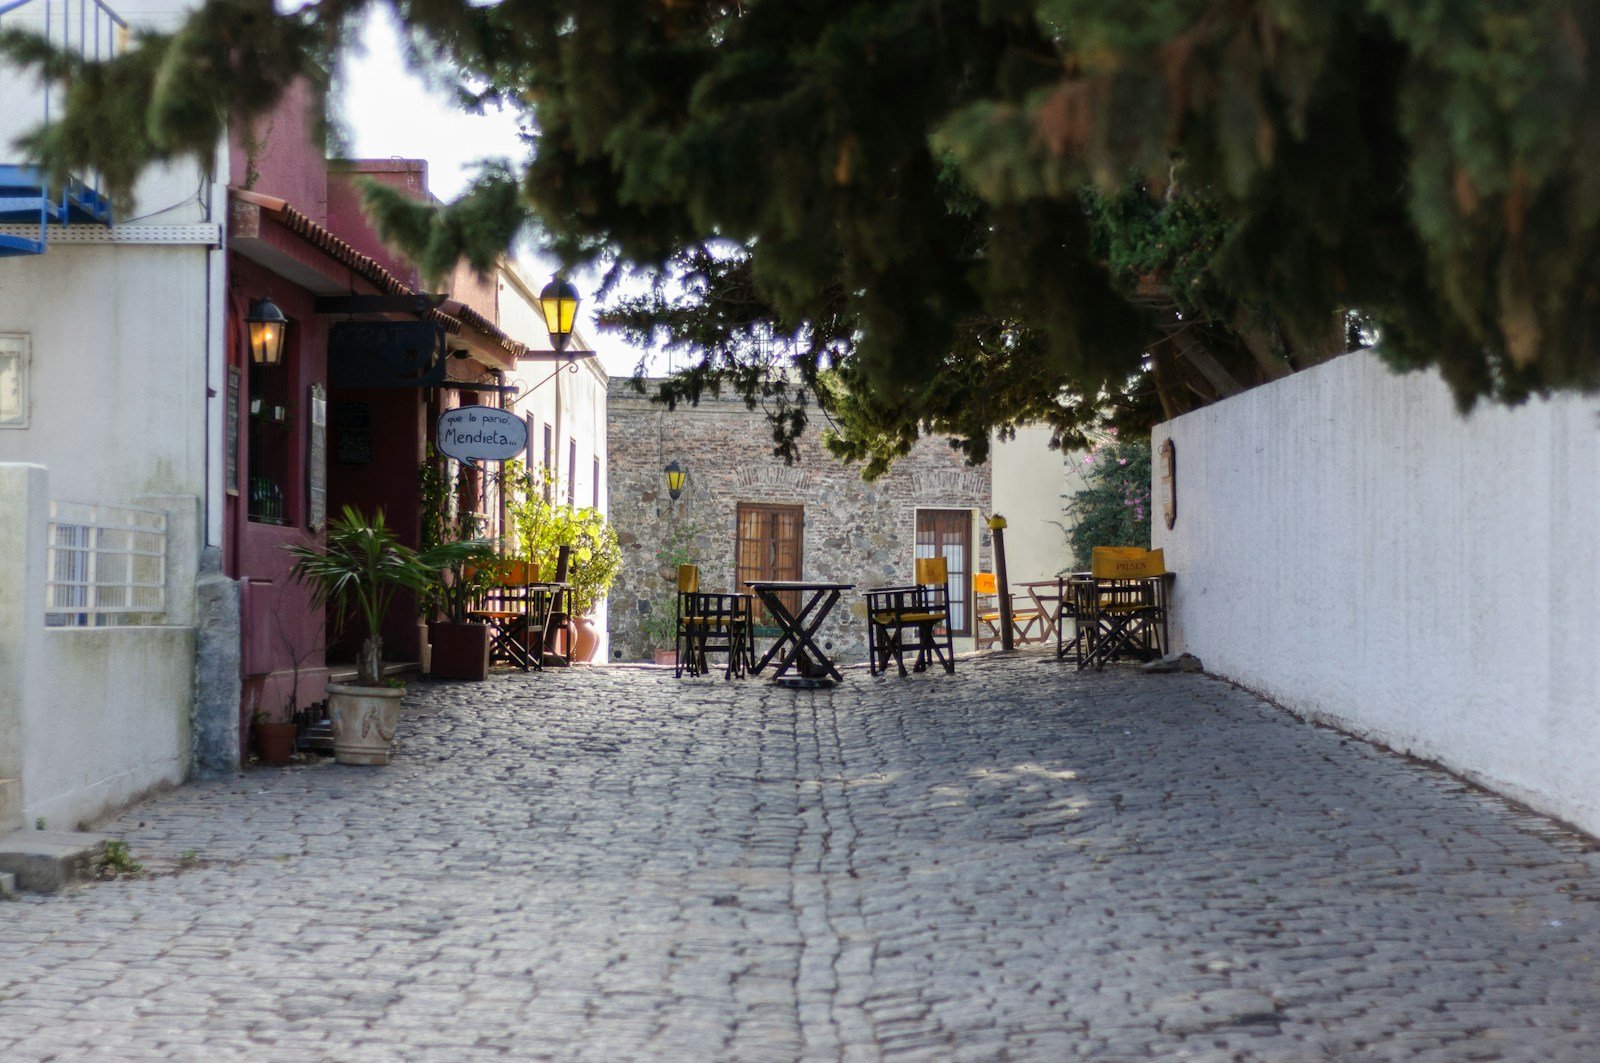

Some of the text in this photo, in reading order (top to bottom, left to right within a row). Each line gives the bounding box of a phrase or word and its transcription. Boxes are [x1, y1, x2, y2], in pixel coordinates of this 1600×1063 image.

[469, 413, 476, 422] lo
[445, 429, 517, 445] Mendieta...
[1116, 561, 1146, 570] PILSEN
